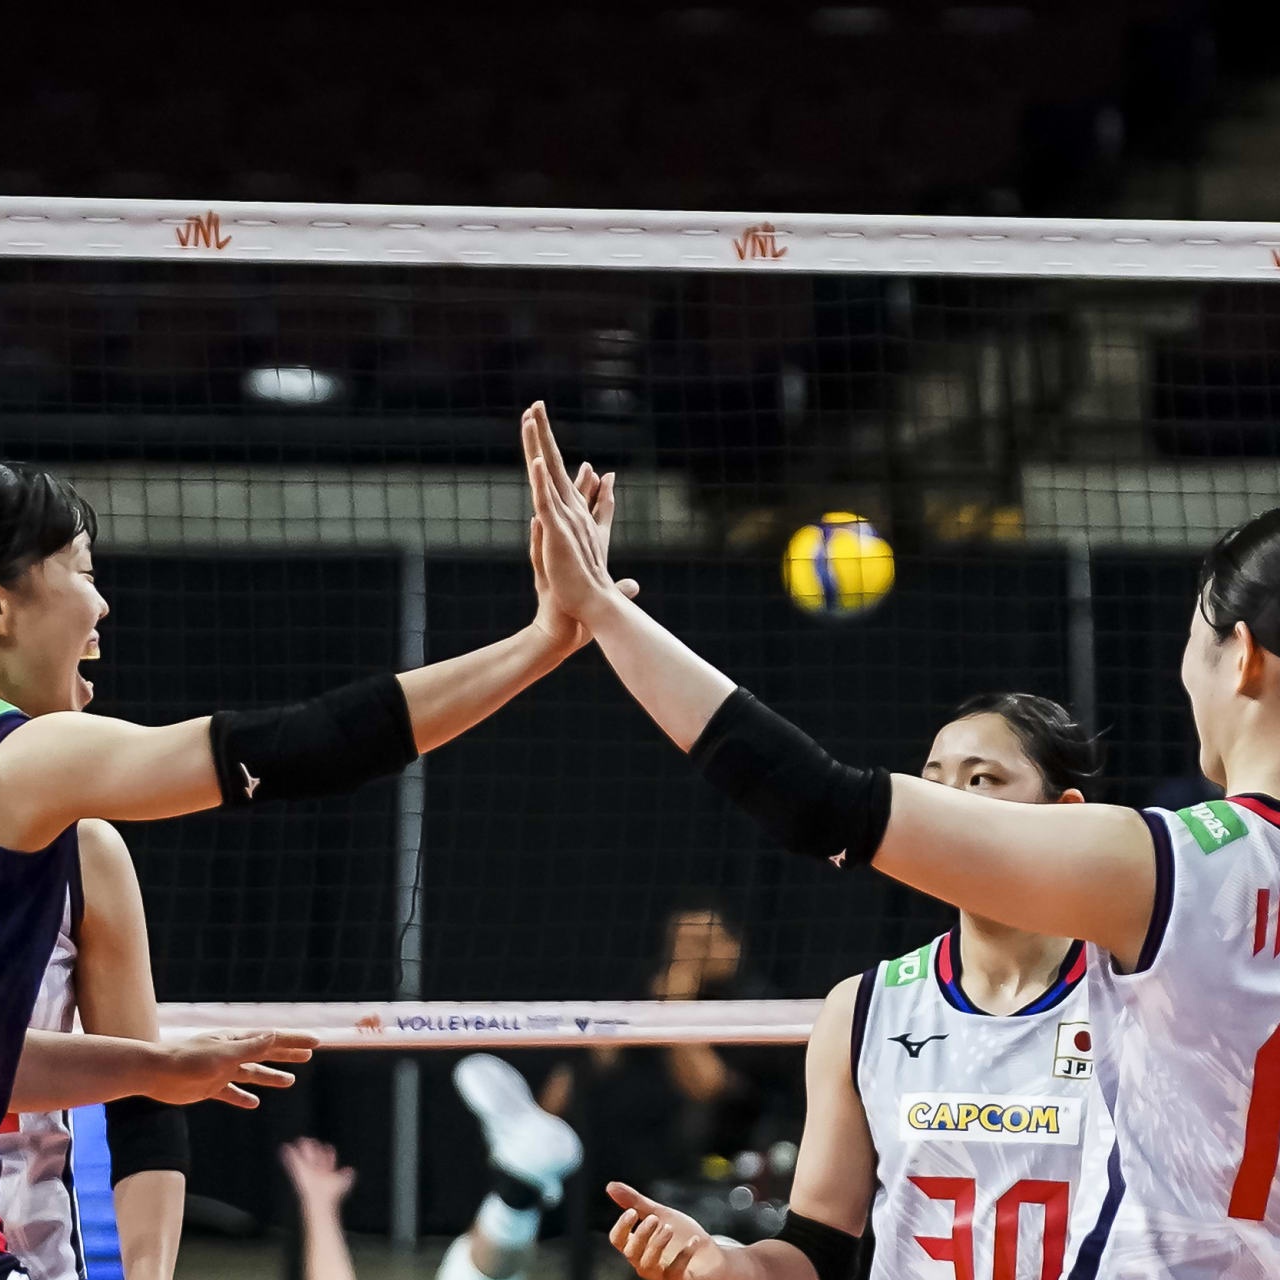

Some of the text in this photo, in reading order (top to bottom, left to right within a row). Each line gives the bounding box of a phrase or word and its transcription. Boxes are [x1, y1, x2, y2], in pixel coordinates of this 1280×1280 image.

[176, 210, 232, 250] VNL
[397, 1015, 521, 1031] VOLLEYBALL
[1063, 1060, 1093, 1076] JP
[908, 1102, 1059, 1134] CAPCOM
